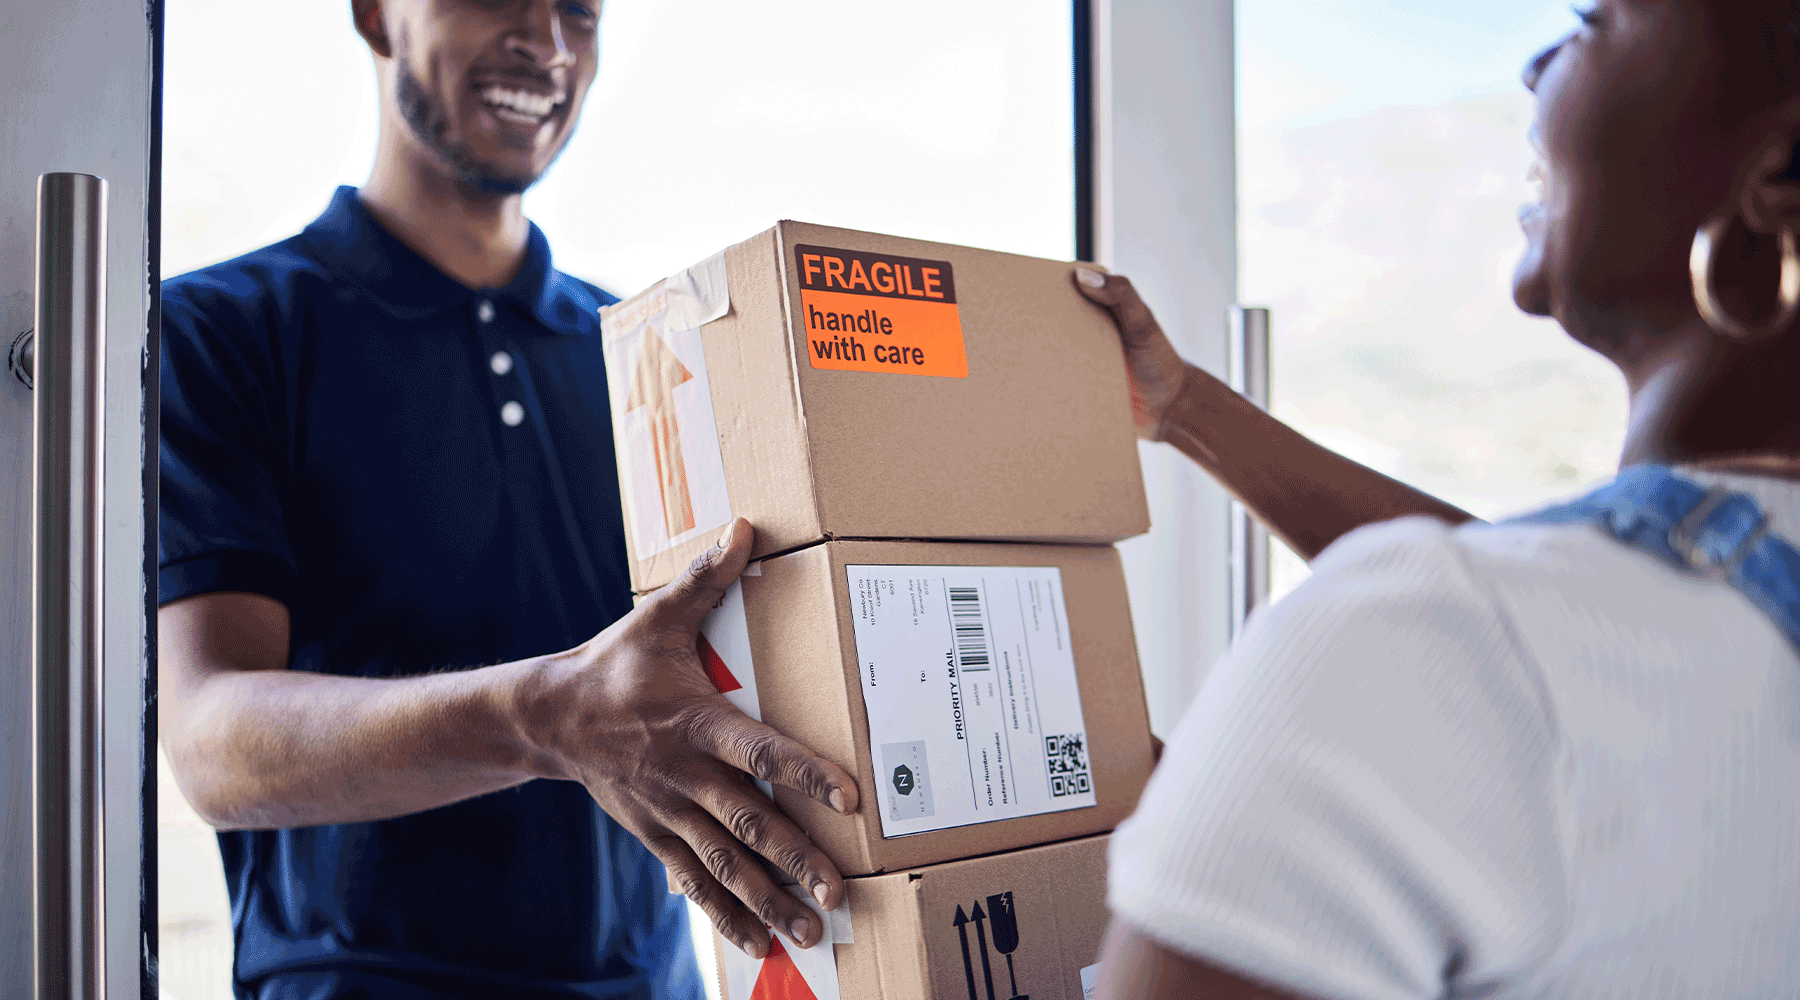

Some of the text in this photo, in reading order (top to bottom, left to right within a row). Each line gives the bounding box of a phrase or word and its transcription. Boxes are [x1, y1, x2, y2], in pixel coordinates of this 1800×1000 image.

[803, 253, 944, 298] FRAGILE
[809, 304, 893, 335] handle
[812, 335, 924, 365] with care
[859, 579, 863, 589] Co
[881, 580, 886, 589] CT
[1004, 651, 1013, 696] Instructions
[946, 648, 964, 739] PRIORITY MAIL
[898, 774, 908, 786] N
[913, 747, 924, 812] NEWBURY CO
[999, 765, 1007, 804] Reference
